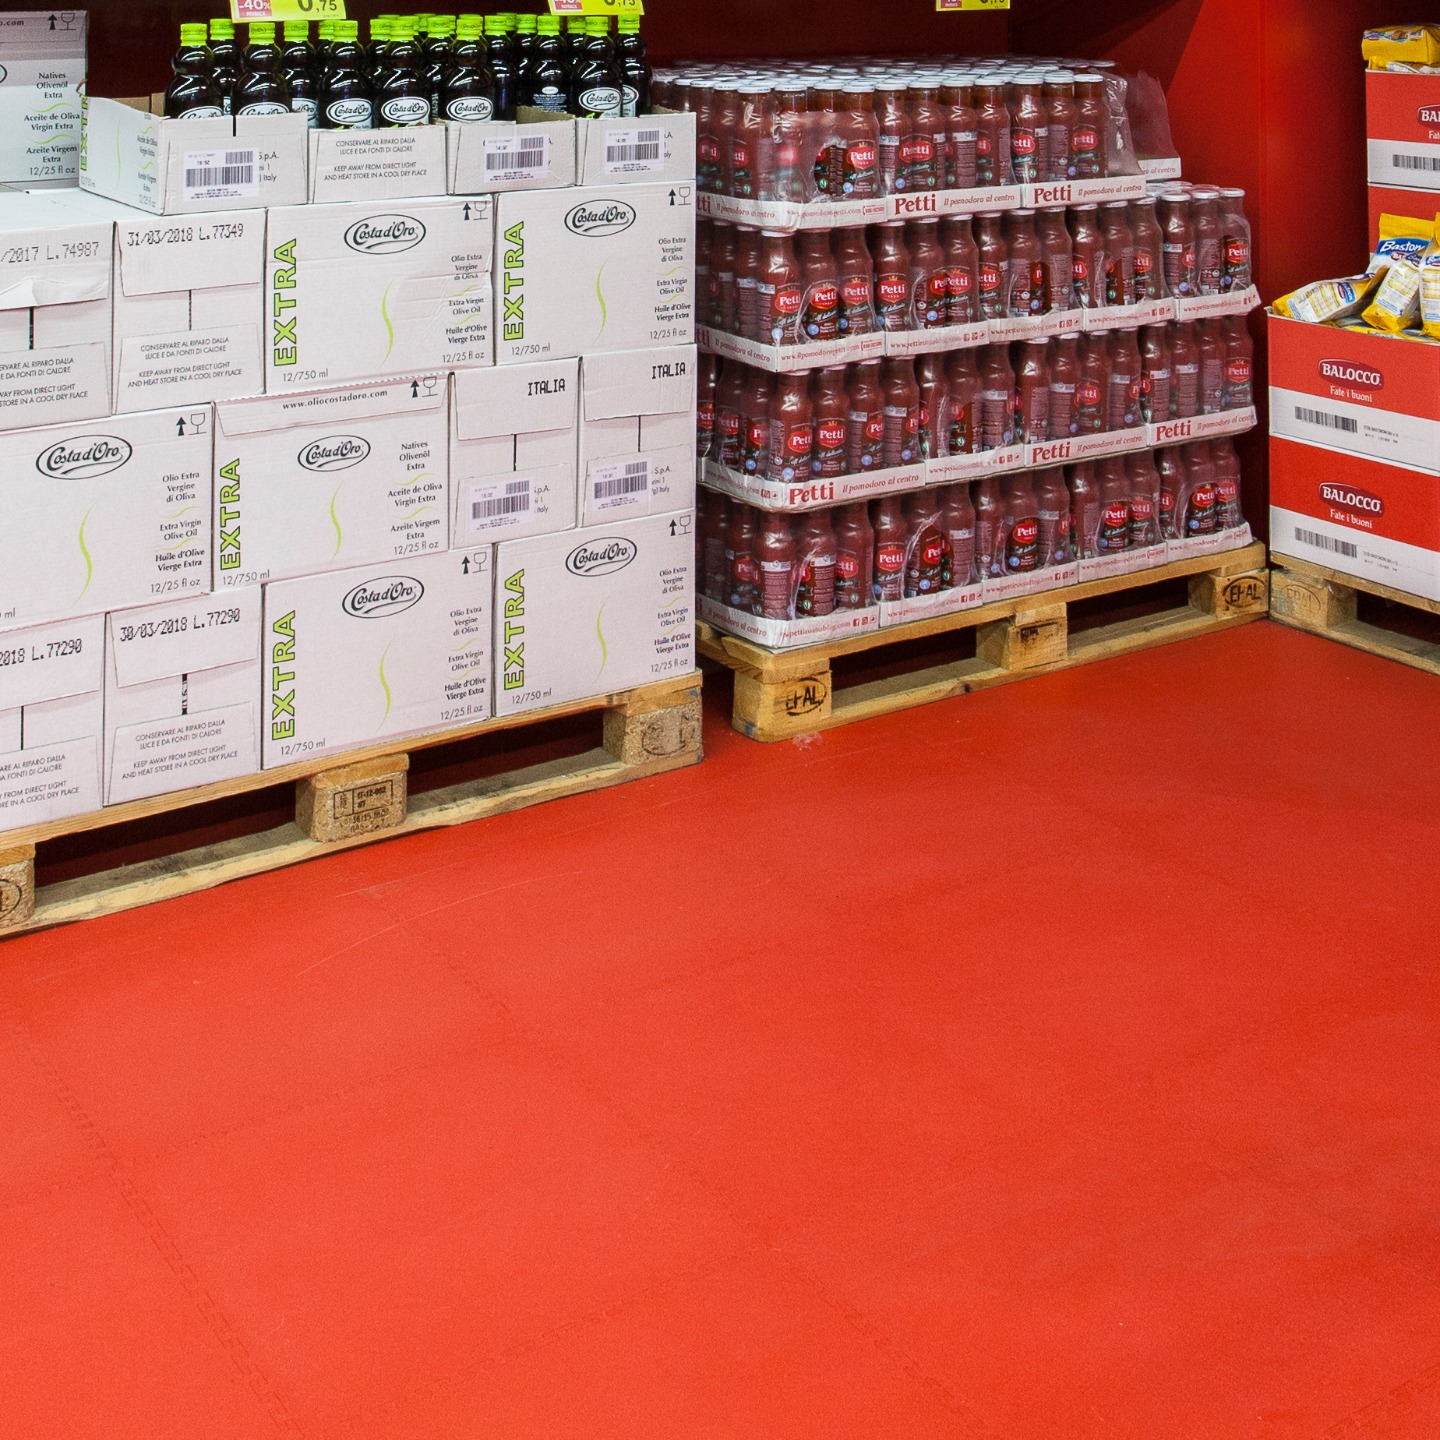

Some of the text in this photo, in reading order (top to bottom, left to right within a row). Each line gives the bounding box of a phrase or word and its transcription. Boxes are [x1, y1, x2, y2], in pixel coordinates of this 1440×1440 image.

[38, 71, 67, 81] Natives
[43, 90, 63, 99] Extra
[895, 193, 937, 215] Petti
[126, 222, 245, 247] 31/03/2018 L.77349
[46, 241, 100, 263] L.74987
[651, 362, 687, 381] ITALIA
[31, 638, 83, 662] L.77290
